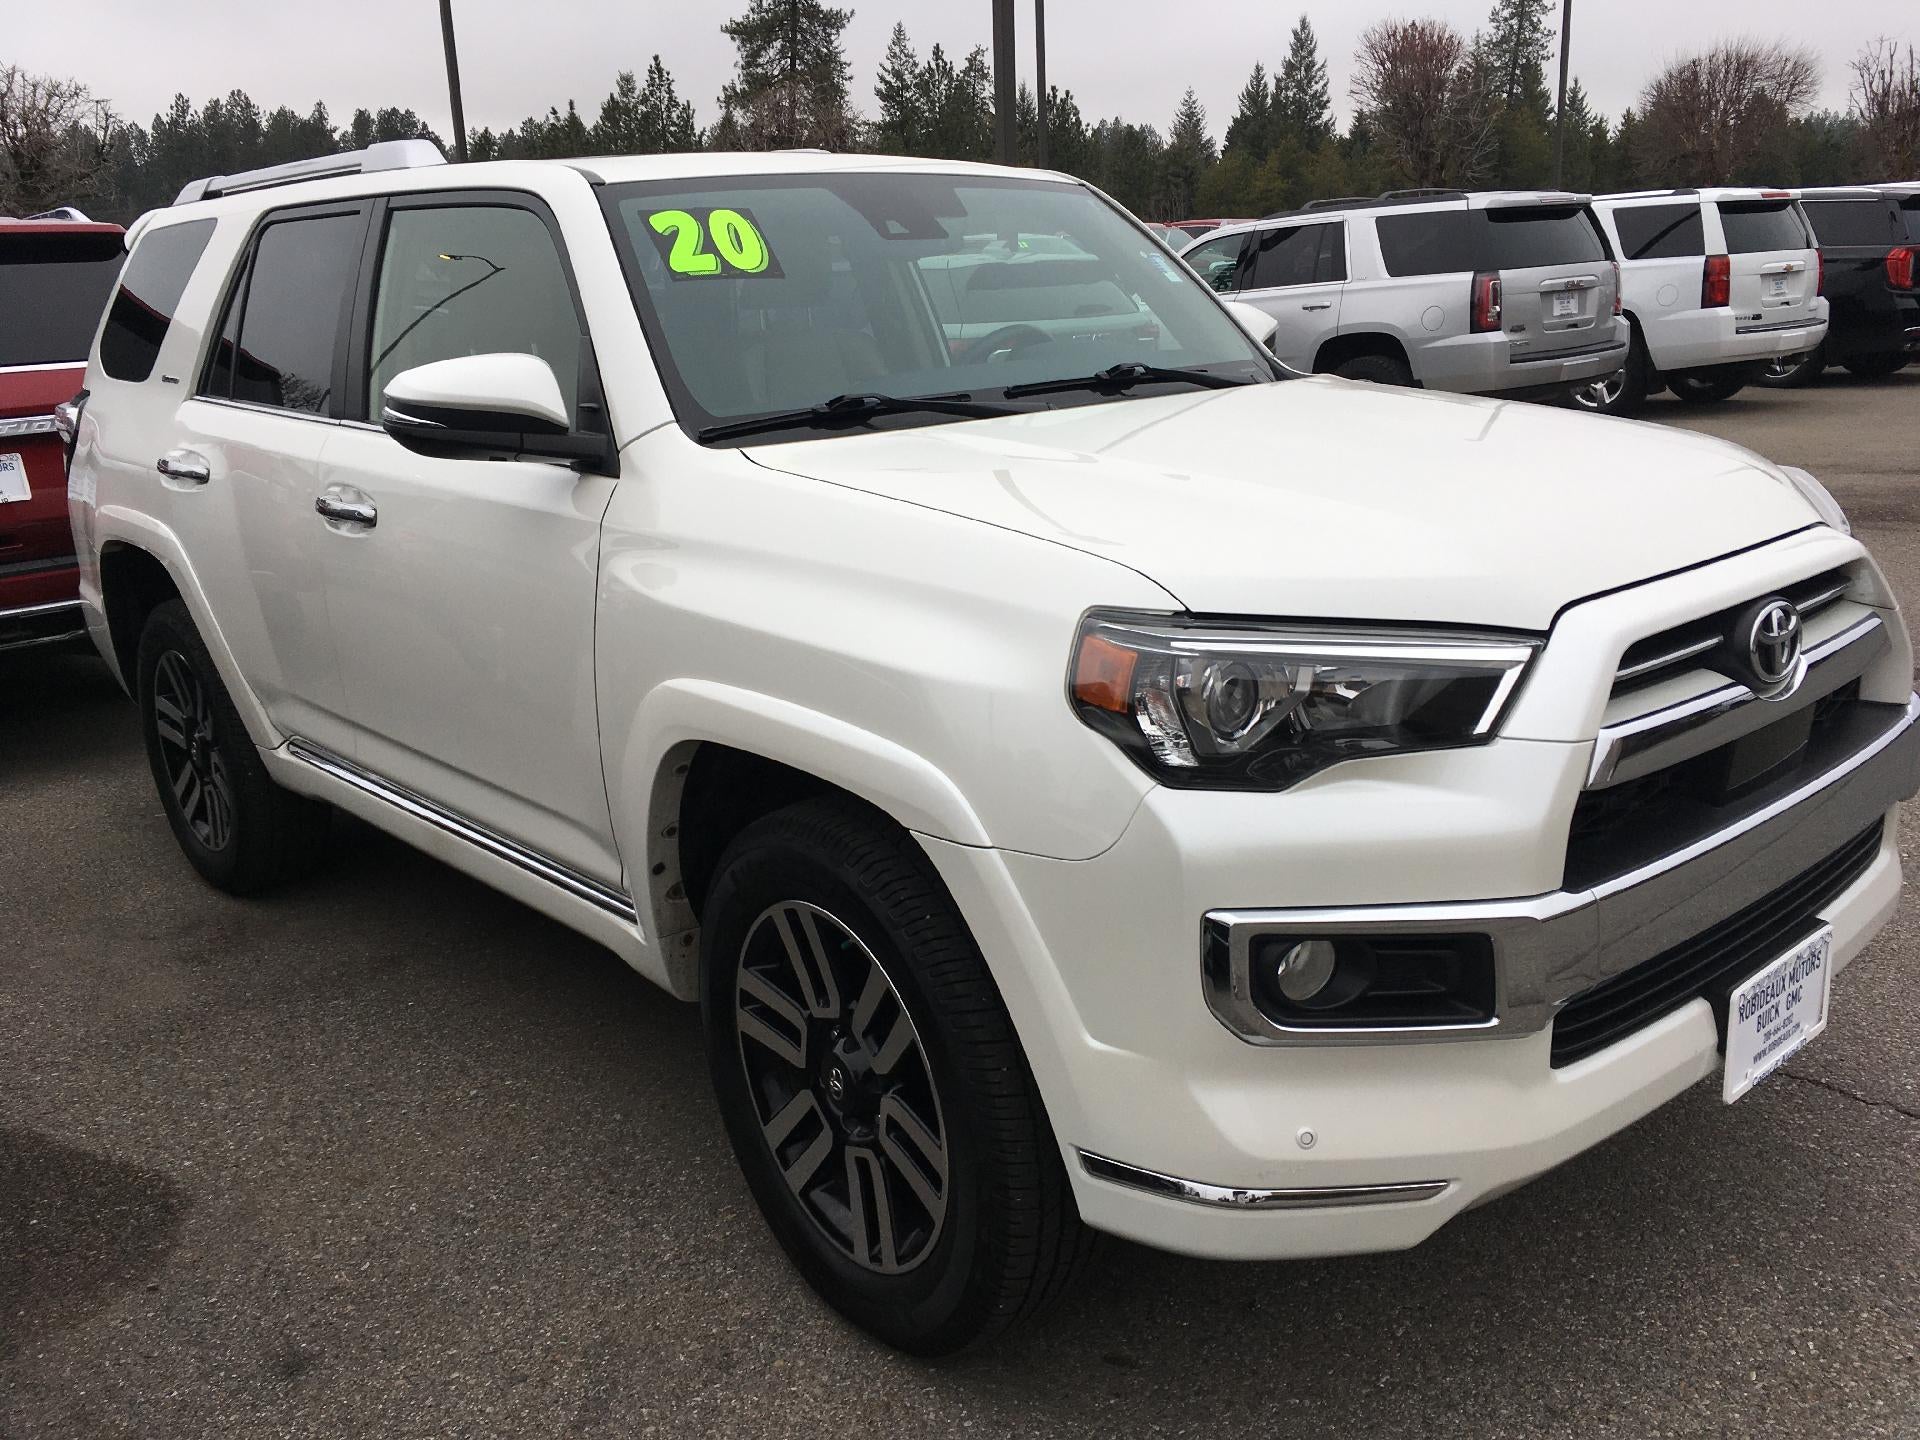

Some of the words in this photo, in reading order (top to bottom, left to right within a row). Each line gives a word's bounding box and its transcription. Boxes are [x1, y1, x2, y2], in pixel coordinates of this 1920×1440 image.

[648, 208, 769, 276] 20
[1738, 974, 1786, 1024] ROBIDEAUX
[1788, 950, 1822, 988] MOTORS
[1756, 999, 1780, 1033] BUICK
[1786, 985, 1803, 1011] GMC
